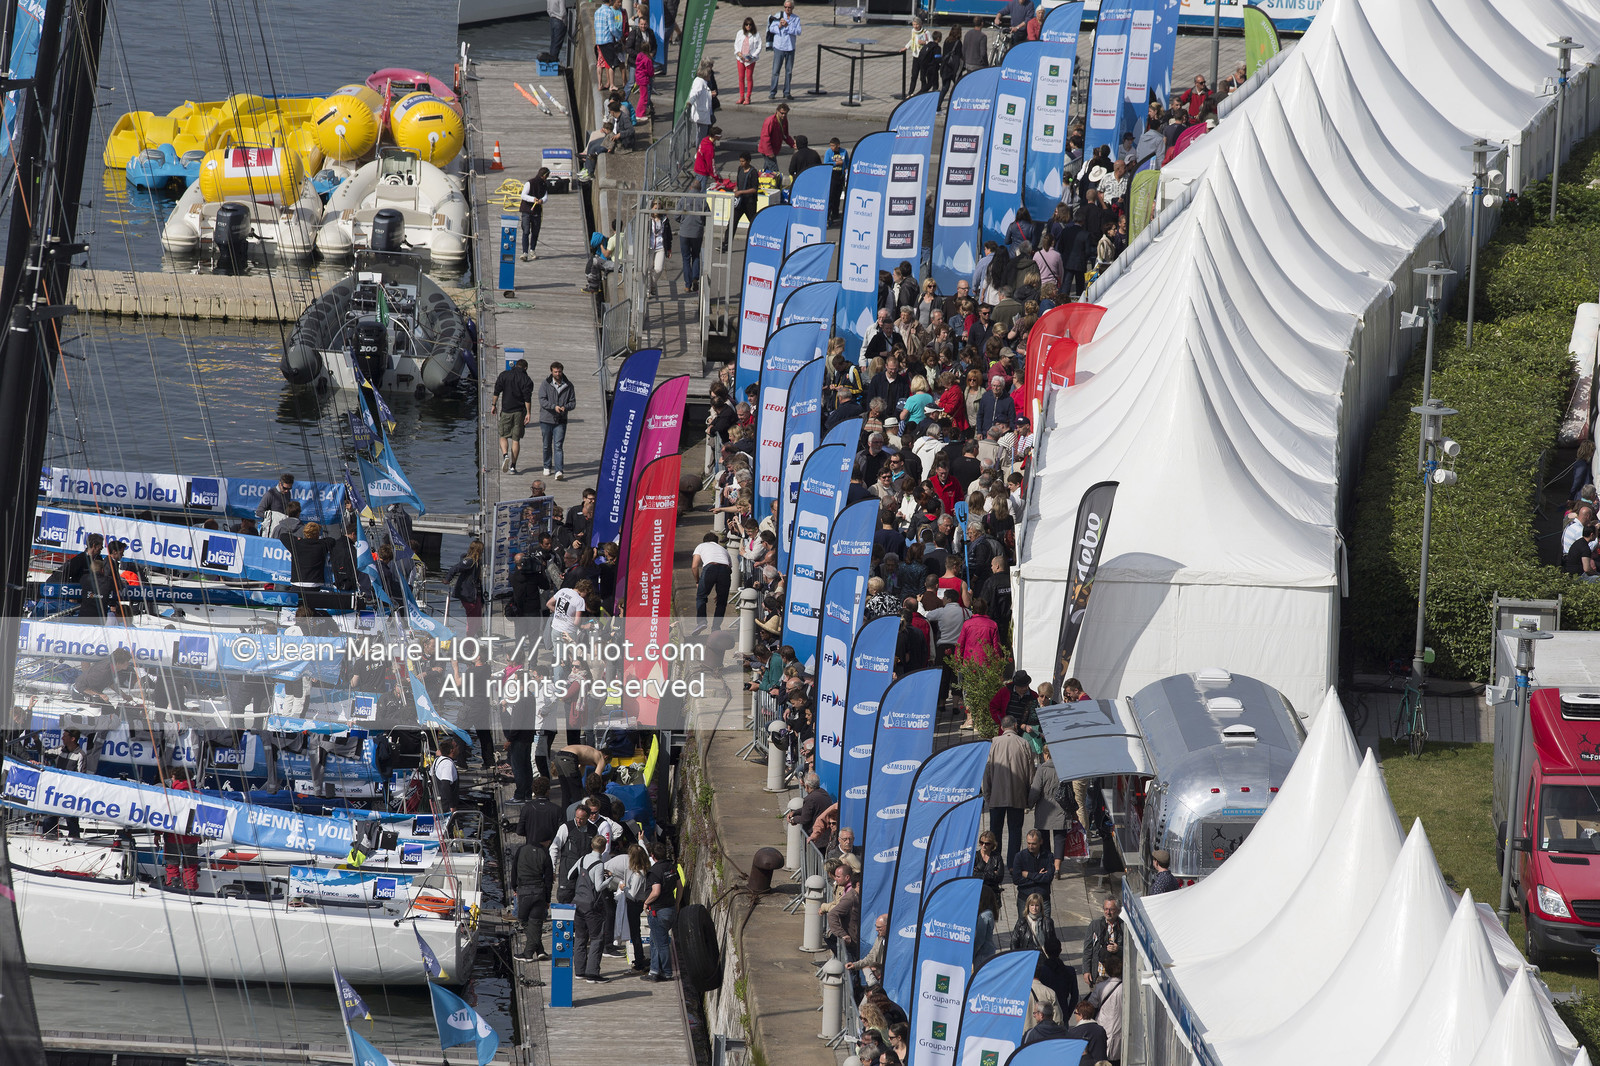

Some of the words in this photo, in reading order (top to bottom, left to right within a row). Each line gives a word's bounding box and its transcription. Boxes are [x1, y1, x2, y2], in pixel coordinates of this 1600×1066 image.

[1040, 76, 1067, 84] Groupama
[1037, 106, 1064, 114] Groupama
[998, 113, 1021, 123] Groupama
[1034, 135, 1061, 143] Groupama
[994, 145, 1018, 154] Groupama
[990, 175, 1017, 185] Groupama
[609, 449, 620, 481] Leader
[610, 455, 626, 524] Classement
[621, 410, 636, 454] Général
[60, 475, 127, 497] france
[135, 482, 177, 503] bleu
[819, 488, 834, 498] voile
[192, 492, 218, 506] bleu
[655, 499, 675, 508] voile
[40, 527, 67, 542] bleu
[150, 537, 192, 560] bleu
[651, 519, 665, 583] Technique
[851, 546, 870, 554] voile
[207, 551, 234, 566] bleu
[156, 589, 193, 599] France
[640, 571, 648, 606] Leader
[37, 634, 109, 657] france
[179, 653, 208, 666] bleu
[873, 663, 888, 672] voile
[857, 703, 878, 711] SAMSUN
[908, 720, 929, 728] voile
[215, 748, 245, 764] bleu
[5, 781, 36, 801] bleu
[45, 786, 120, 819] france
[129, 802, 177, 830] bleu
[193, 821, 223, 839] bleu
[248, 811, 304, 832] BIENNE
[318, 824, 351, 840] VOIL
[403, 853, 422, 862] bleu
[377, 889, 395, 898] bleu
[953, 923, 971, 932] france
[950, 931, 970, 942] voile
[922, 991, 960, 1005] Groupama
[982, 994, 996, 1002] tour
[1004, 998, 1025, 1006] france
[1000, 1005, 1023, 1016] voile
